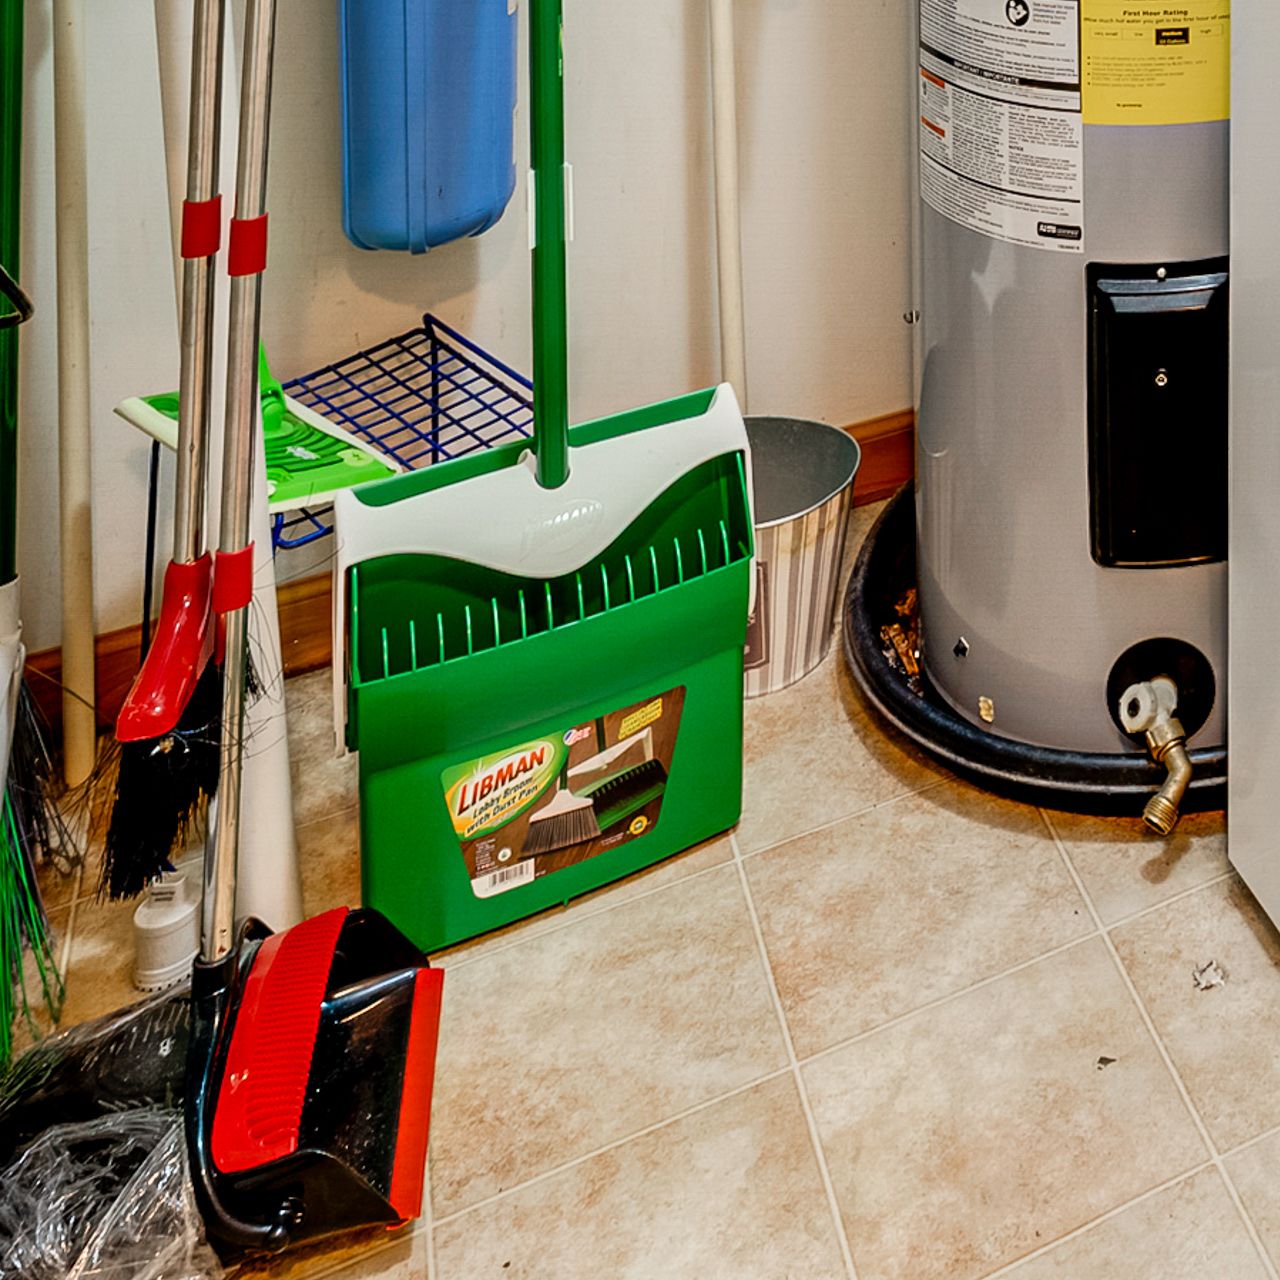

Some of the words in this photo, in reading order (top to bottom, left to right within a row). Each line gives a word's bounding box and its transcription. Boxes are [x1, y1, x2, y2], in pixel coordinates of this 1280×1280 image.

[457, 746, 546, 816] LIBMAN
[472, 795, 501, 820] Lobby
[502, 776, 534, 800] Broom
[466, 811, 491, 835] with
[492, 795, 517, 817] Dust
[518, 784, 538, 802] Pan
